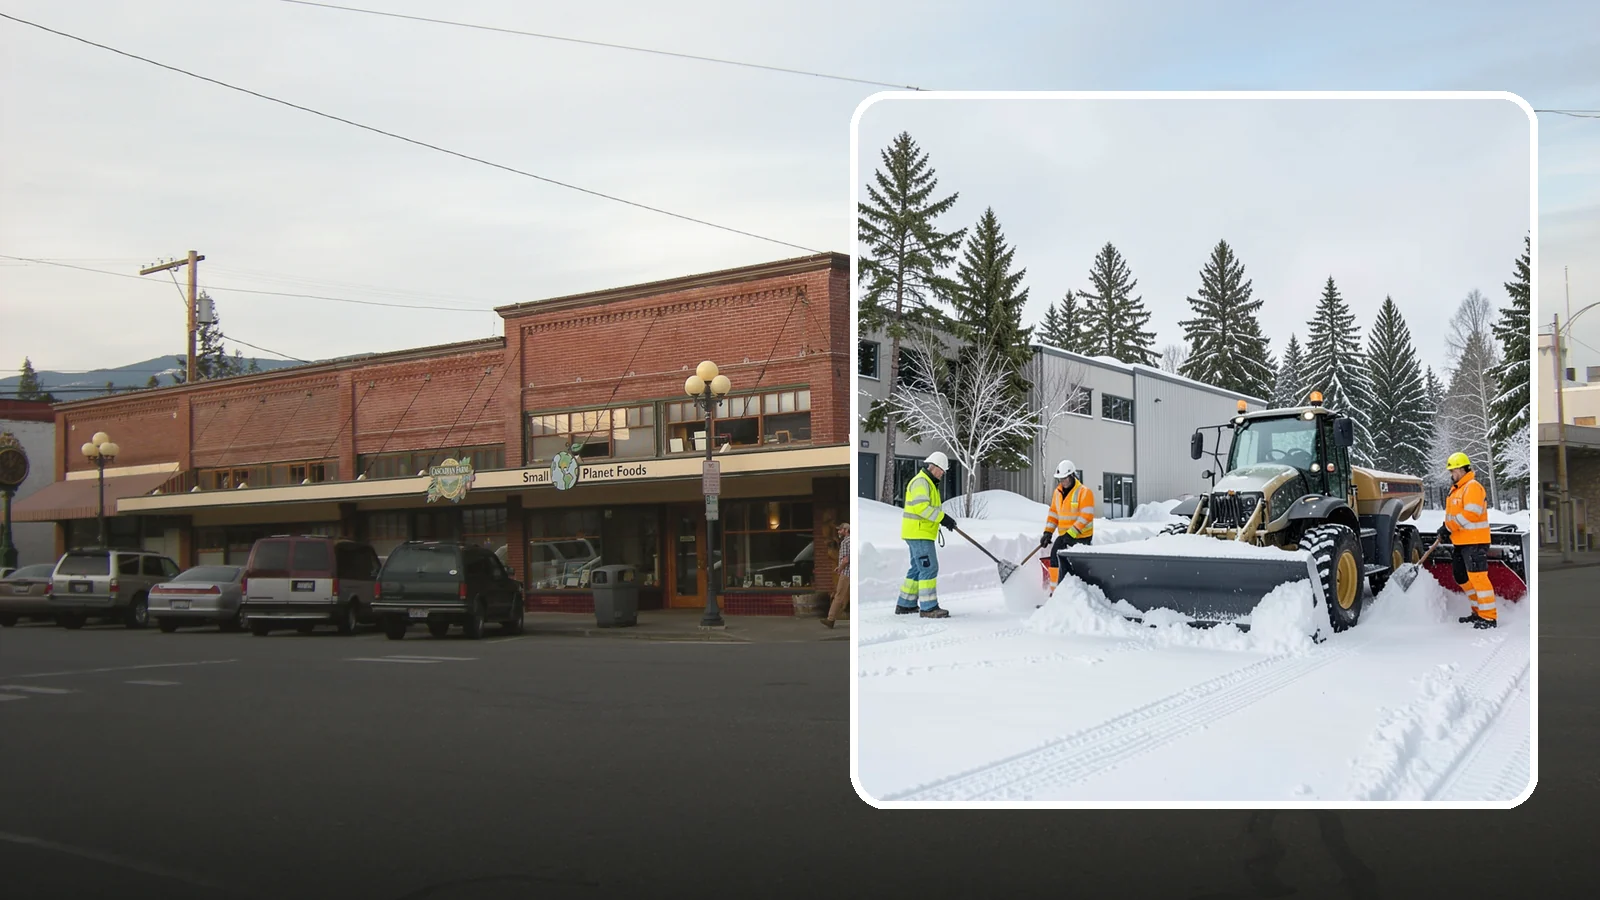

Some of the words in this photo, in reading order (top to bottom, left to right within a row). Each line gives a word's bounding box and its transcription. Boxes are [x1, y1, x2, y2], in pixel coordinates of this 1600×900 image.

[523, 471, 549, 483] Small
[583, 468, 614, 480] Planet
[616, 464, 647, 478] Foods
